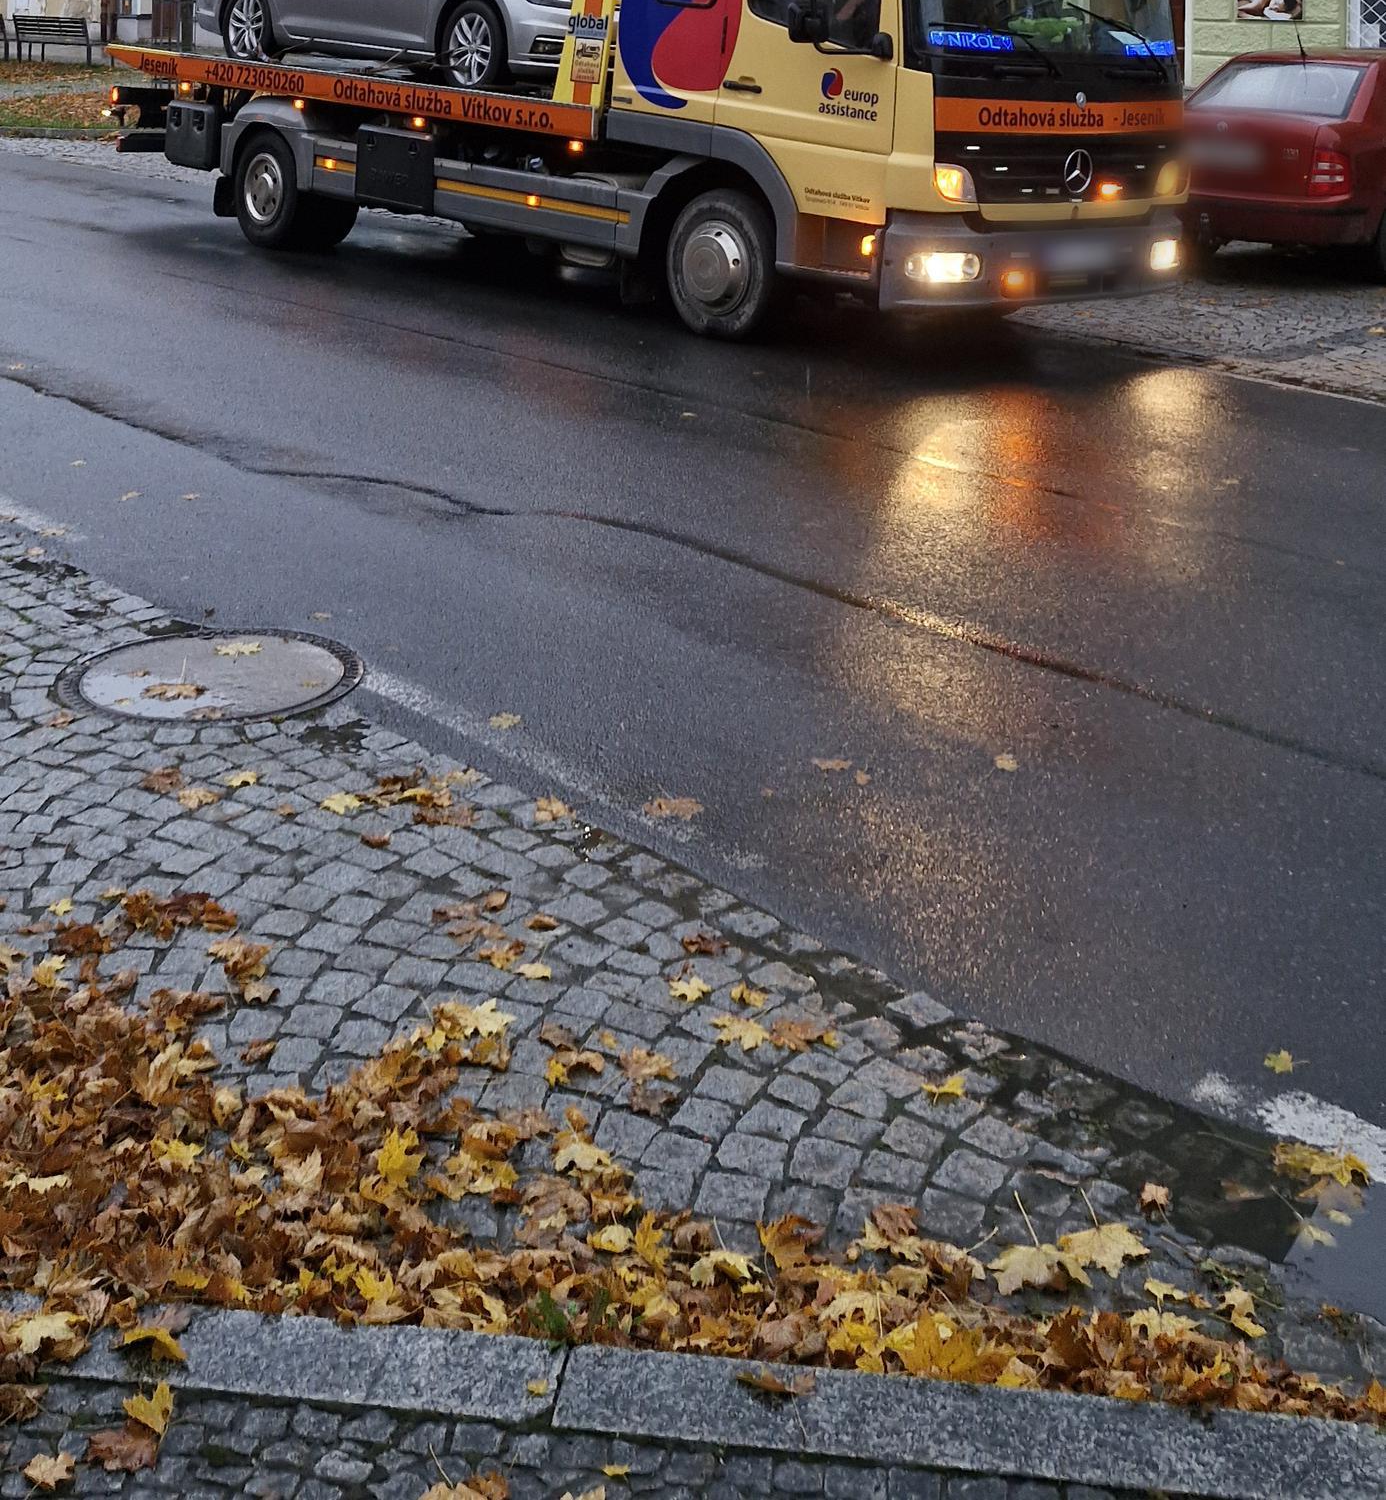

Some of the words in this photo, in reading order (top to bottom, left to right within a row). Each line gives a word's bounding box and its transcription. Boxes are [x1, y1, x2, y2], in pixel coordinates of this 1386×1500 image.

[567, 12, 609, 34] global
[138, 55, 178, 77] Jeseník
[205, 63, 234, 83] +420
[236, 66, 305, 93] 723050260
[333, 79, 401, 108] Odtahová
[404, 89, 451, 115] služba
[461, 96, 512, 122] Vítkov
[515, 107, 554, 130] s.r.o.
[844, 88, 879, 106] europ
[818, 101, 878, 122] assistance
[978, 106, 1056, 127] Odtahová
[1059, 108, 1104, 127] služba
